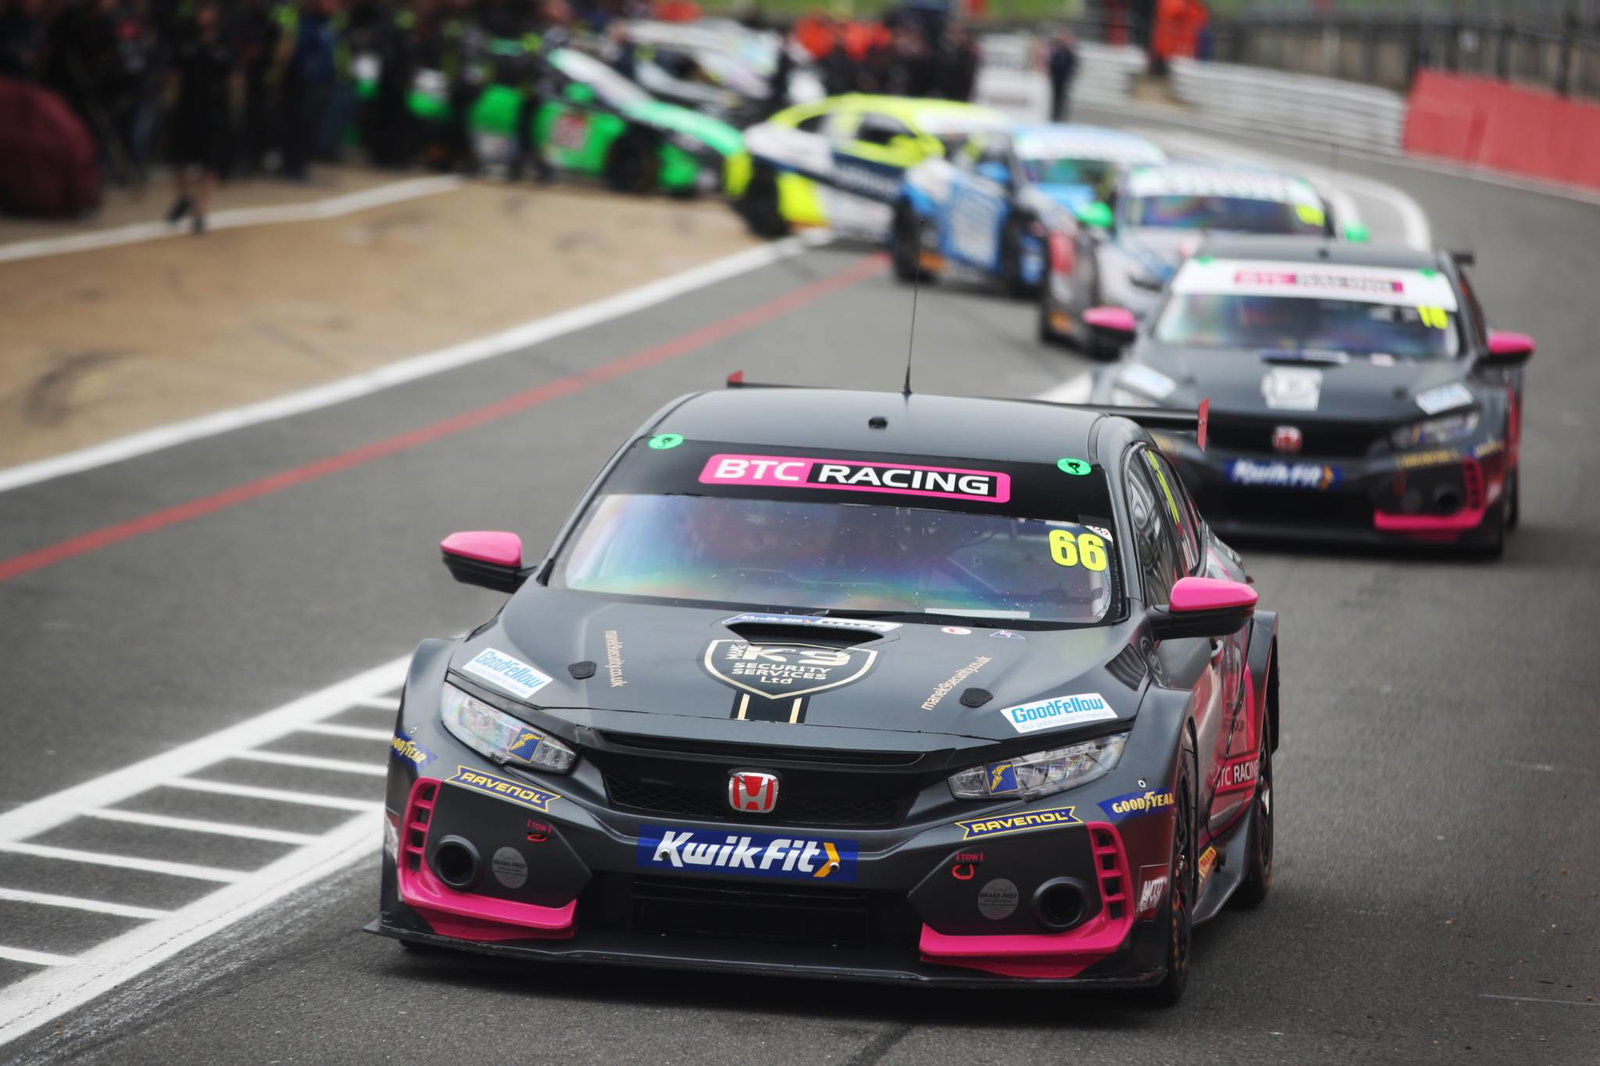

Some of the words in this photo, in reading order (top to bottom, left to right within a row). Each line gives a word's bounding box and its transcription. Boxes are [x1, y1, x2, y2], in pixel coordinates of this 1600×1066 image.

[713, 458, 805, 482] BTC
[817, 463, 990, 496] RACING
[1048, 529, 1107, 573] 66
[731, 667, 828, 681] SERVICES
[732, 661, 832, 674] SECURITY
[760, 676, 793, 685] Ltd
[1011, 696, 1105, 724] GoodFellow
[459, 771, 546, 805] RAVENOL
[971, 812, 1069, 833] RAVENOL
